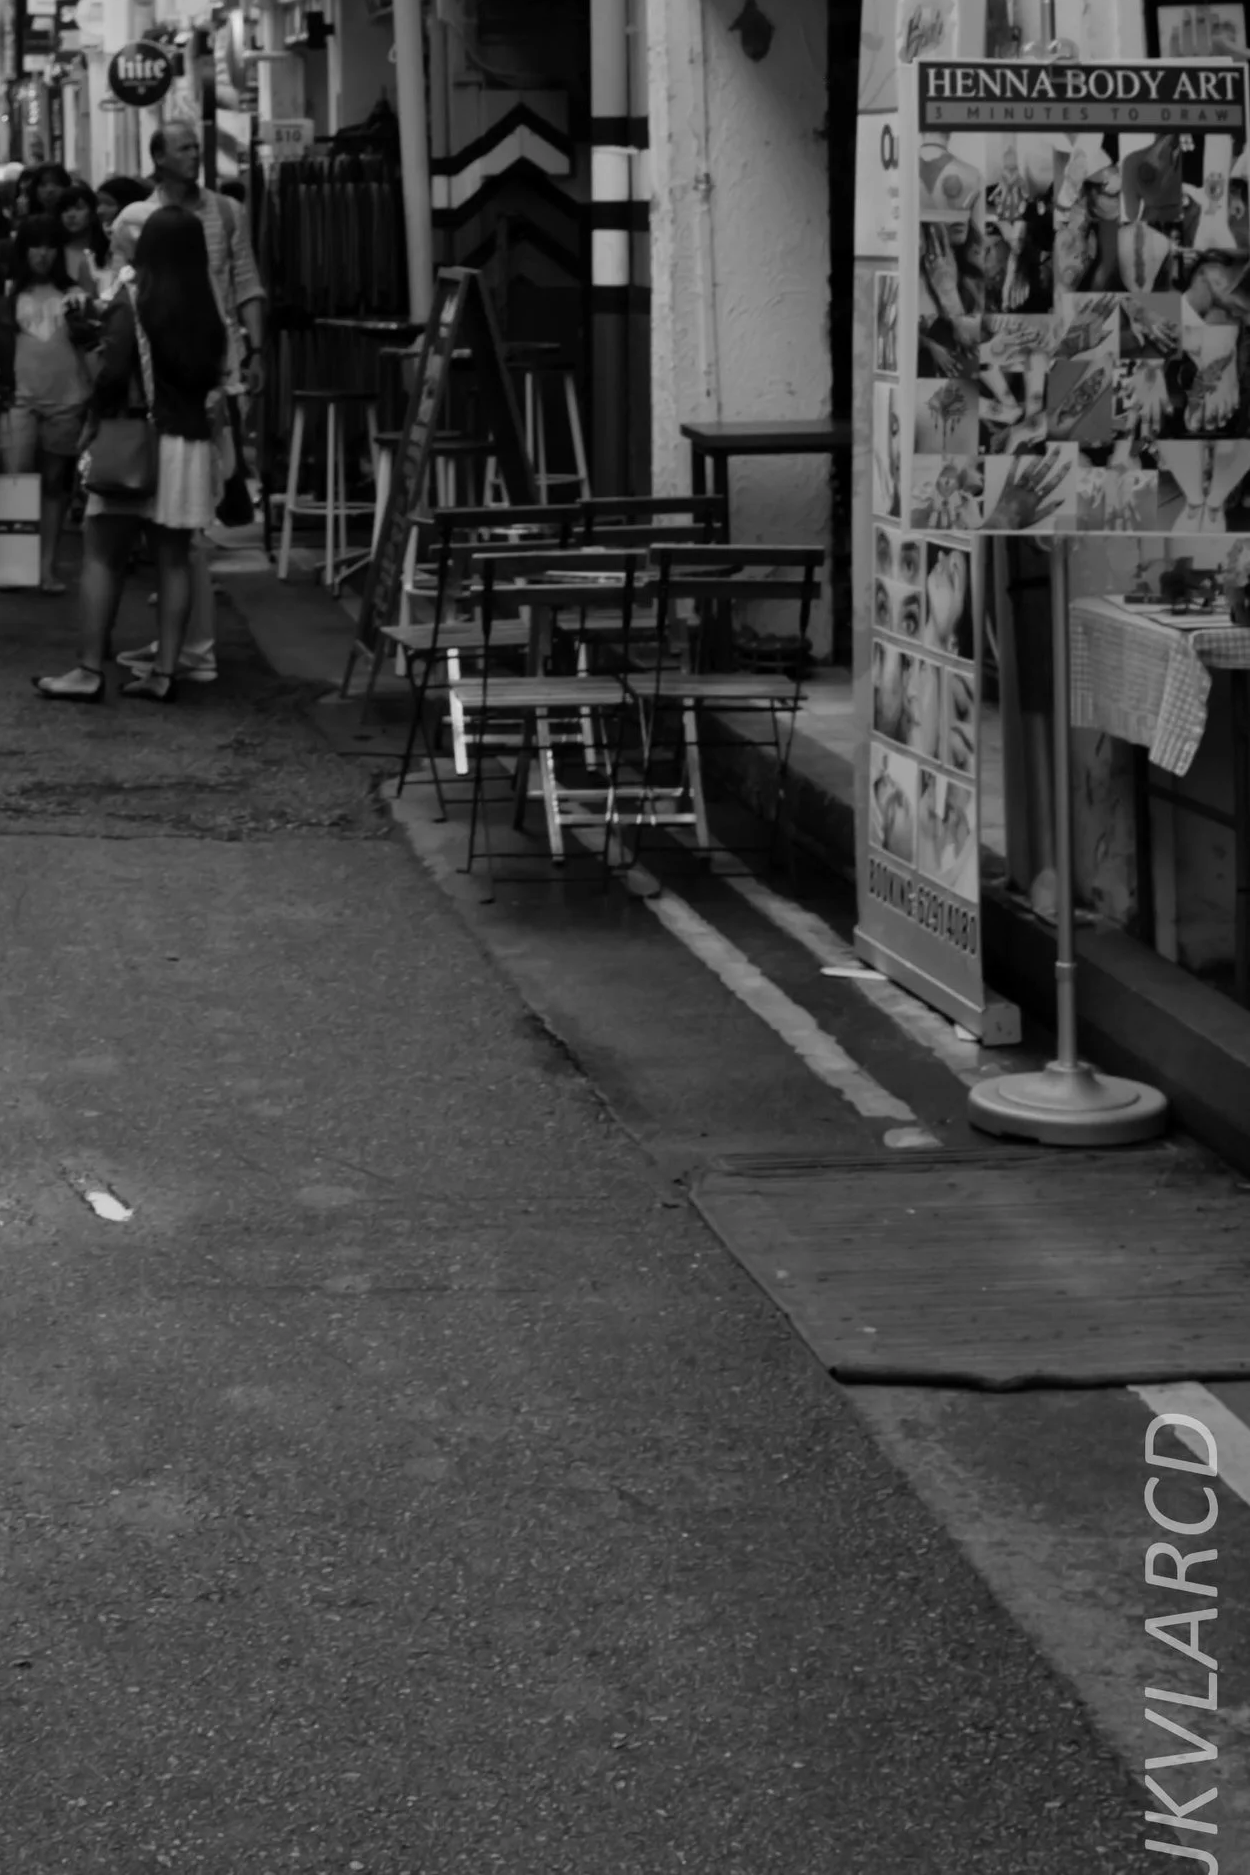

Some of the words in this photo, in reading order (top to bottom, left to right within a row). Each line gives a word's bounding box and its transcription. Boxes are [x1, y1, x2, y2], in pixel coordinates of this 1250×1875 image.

[926, 68, 1056, 98] HENNA
[1065, 69, 1165, 100] BODY
[1172, 71, 1240, 101] ART
[935, 106, 943, 120] 3
[967, 106, 1089, 121] MINUTES
[1111, 107, 1139, 121] TO
[1160, 108, 1229, 121] DRAW
